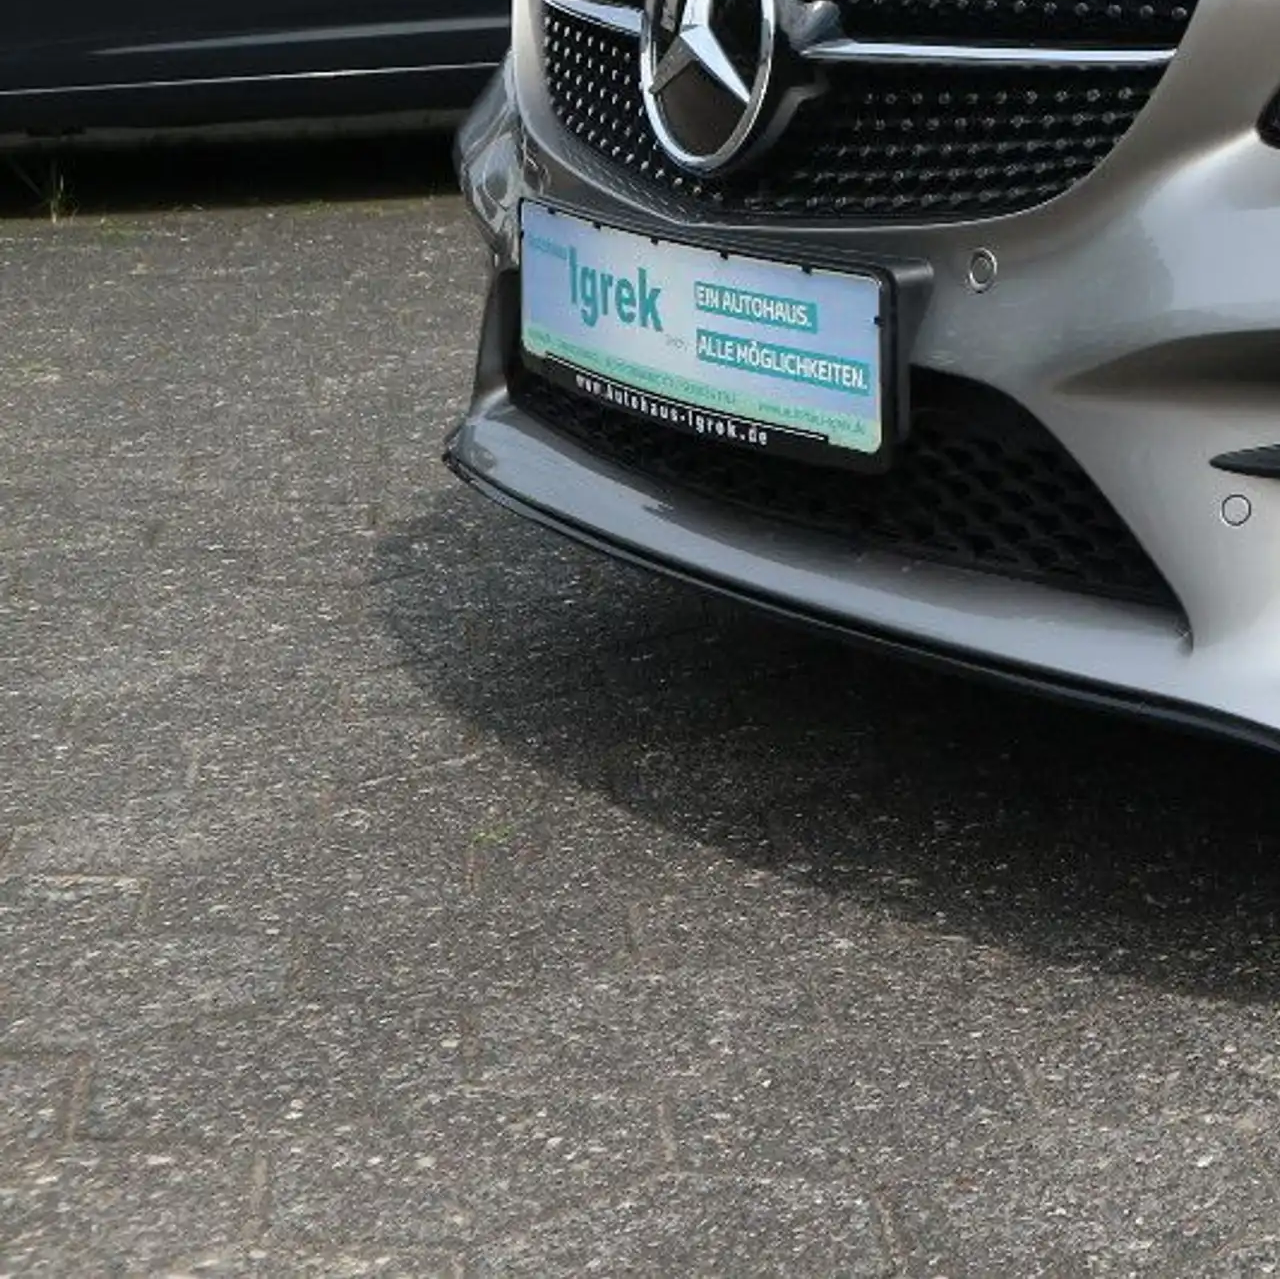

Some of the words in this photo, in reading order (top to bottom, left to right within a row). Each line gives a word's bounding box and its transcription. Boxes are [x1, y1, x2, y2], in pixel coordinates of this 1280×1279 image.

[568, 245, 664, 332] Igrek
[696, 285, 720, 309] EIN
[698, 335, 735, 363] ALLE
